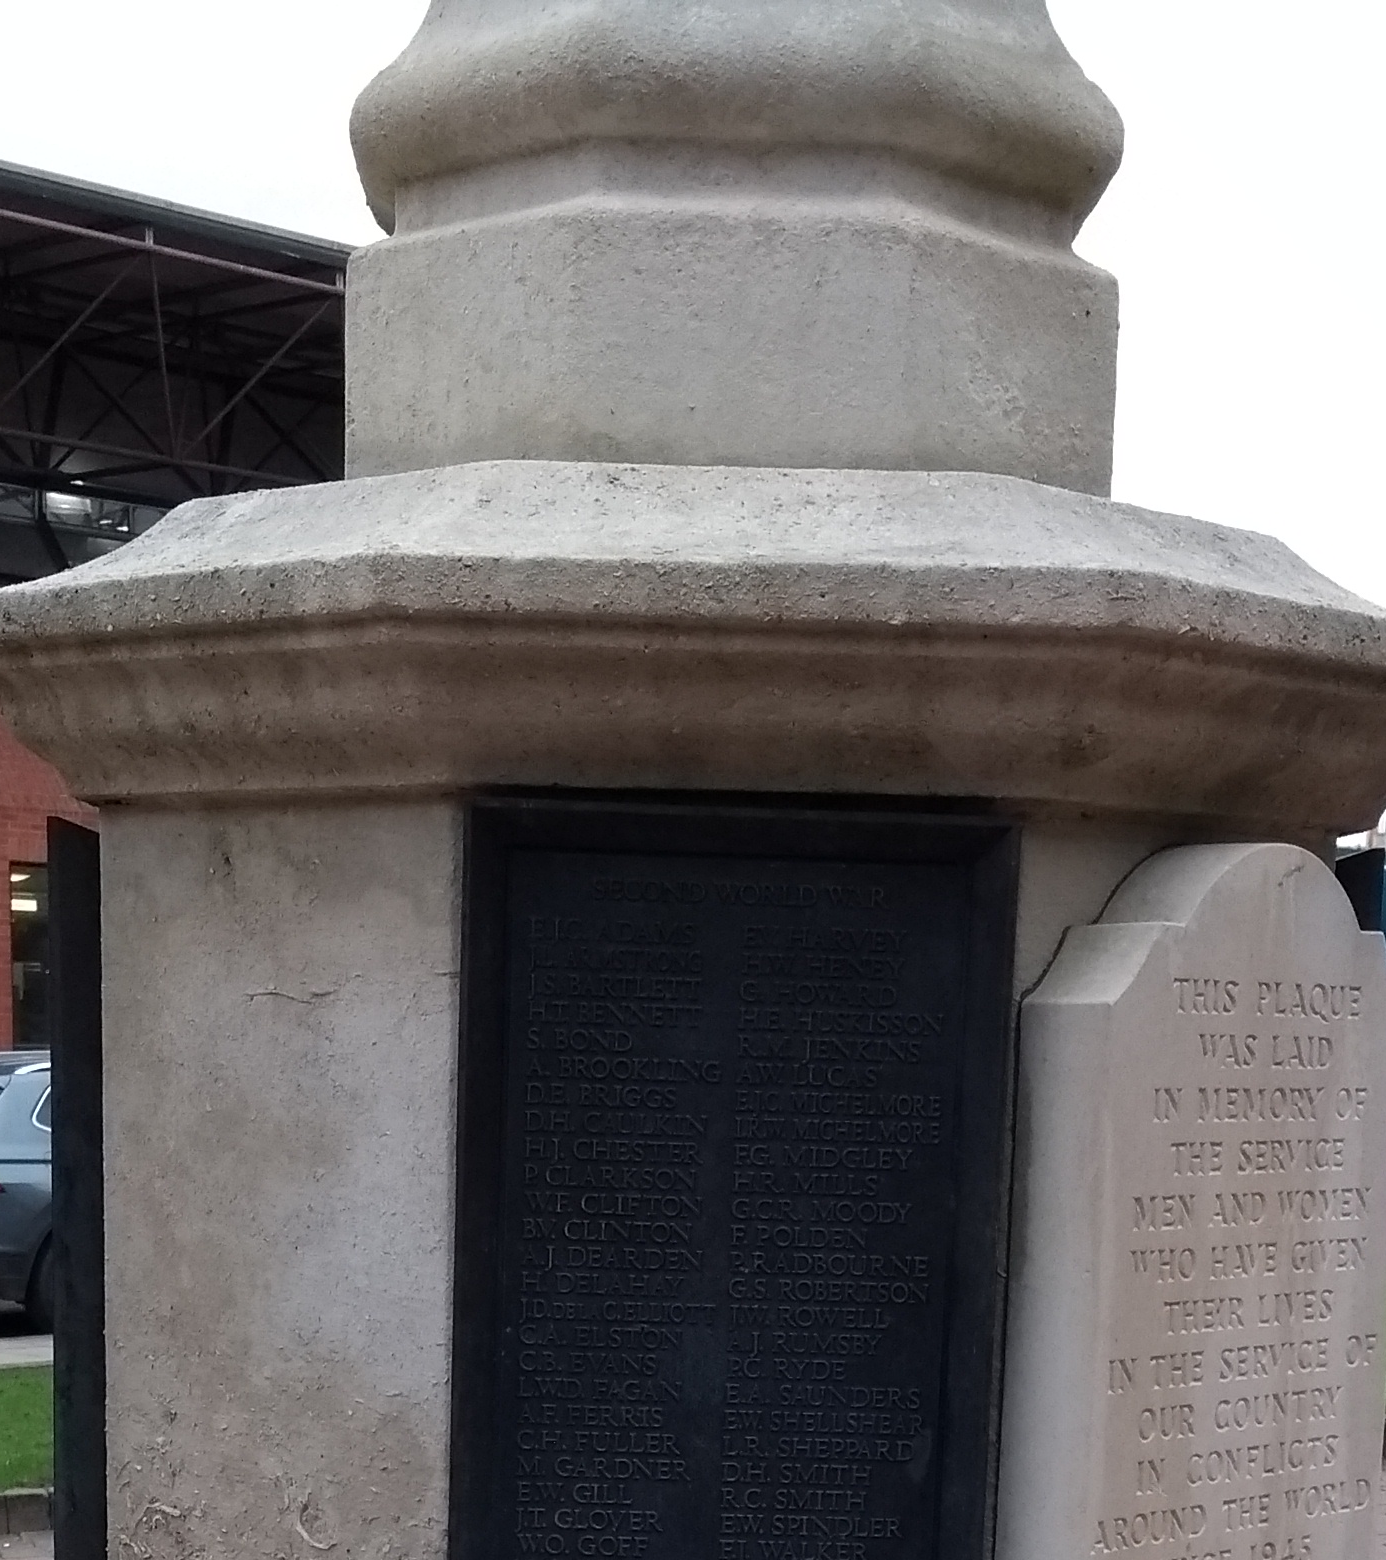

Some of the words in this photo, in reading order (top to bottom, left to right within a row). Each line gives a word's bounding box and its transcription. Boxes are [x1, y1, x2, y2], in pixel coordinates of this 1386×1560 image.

[592, 878, 707, 905] SECOND
[714, 882, 818, 908] WORLD
[825, 885, 889, 910] WAR
[597, 918, 696, 944] ADAMS
[805, 955, 906, 979] HENEY
[568, 974, 702, 1000] BARTLETT
[773, 982, 898, 1007] HOWARD
[1173, 978, 1240, 1014] THIS
[1256, 981, 1363, 1023] PLAQUE
[577, 1002, 702, 1027] BENNETT
[792, 1009, 944, 1035] HUSKISSON
[554, 1028, 632, 1052] BOND
[802, 1037, 922, 1066] JENKINS
[1199, 1033, 1258, 1069] WAS
[1271, 1034, 1334, 1070] LAID
[558, 1056, 721, 1082] BROOKLING
[792, 1064, 878, 1087] LUCAS
[579, 1084, 677, 1107] BRIGGS
[790, 1092, 942, 1116] MICHELMORE
[1152, 1087, 1183, 1123] IN
[1197, 1086, 1325, 1123] MEMORY
[1335, 1087, 1368, 1121] OF
[584, 1112, 707, 1136] CAULKIN
[573, 1139, 705, 1164] CHESTER
[783, 1146, 914, 1170] MIDGLEY
[1170, 1141, 1224, 1177] THE
[1237, 1138, 1346, 1175] SERVICE
[793, 1173, 878, 1196] MILLS
[580, 1193, 703, 1217] CLIFTON
[810, 1200, 912, 1223] MOODY
[1132, 1194, 1197, 1231] MEN
[1207, 1192, 1267, 1228] AND
[1278, 1187, 1373, 1223] WOMEN
[564, 1220, 692, 1243] CLINTON
[756, 1225, 867, 1249] POLDEN
[567, 1247, 702, 1271] DEARDEN
[1130, 1247, 1197, 1283] WHO
[1210, 1242, 1278, 1281] HAVE
[1291, 1237, 1368, 1274] GIVEN
[555, 1273, 684, 1296] DELAHAY
[779, 1279, 929, 1304] ROBERTSON
[778, 1306, 889, 1329] ROWELL
[1163, 1297, 1245, 1336] THEIR
[1257, 1289, 1335, 1327] LIVES
[574, 1326, 683, 1349] ELSTON
[772, 1332, 881, 1355] RUMSBY
[570, 1352, 657, 1374] EVANS
[773, 1358, 846, 1380] RYDE
[1107, 1358, 1139, 1395] IN
[1149, 1351, 1205, 1390] THE
[1218, 1338, 1330, 1383] SERVICE
[1345, 1333, 1378, 1368] OF
[593, 1379, 681, 1402] FAGAN
[779, 1385, 921, 1409] SAUNDERS
[567, 1405, 663, 1427] FERRIS
[769, 1410, 923, 1435] SHELLSHEAR
[1138, 1403, 1196, 1443] OUR
[1214, 1386, 1343, 1433] COUNTRY
[574, 1431, 680, 1453] FULLER
[777, 1437, 915, 1461] SHEPPARD
[554, 1457, 692, 1480] GARDNER
[779, 1463, 871, 1485] SMITH
[1135, 1458, 1167, 1496] IN
[1186, 1434, 1340, 1487] CONFLICTS
[573, 1483, 632, 1504] GILL
[774, 1489, 866, 1511] SMITH
[554, 1509, 663, 1531] GLOVER
[771, 1514, 904, 1538] SPINDLER
[1090, 1504, 1207, 1555] AROUND
[1222, 1494, 1272, 1533] THE
[1284, 1478, 1372, 1518] WORLD
[578, 1535, 649, 1556] GOFF
